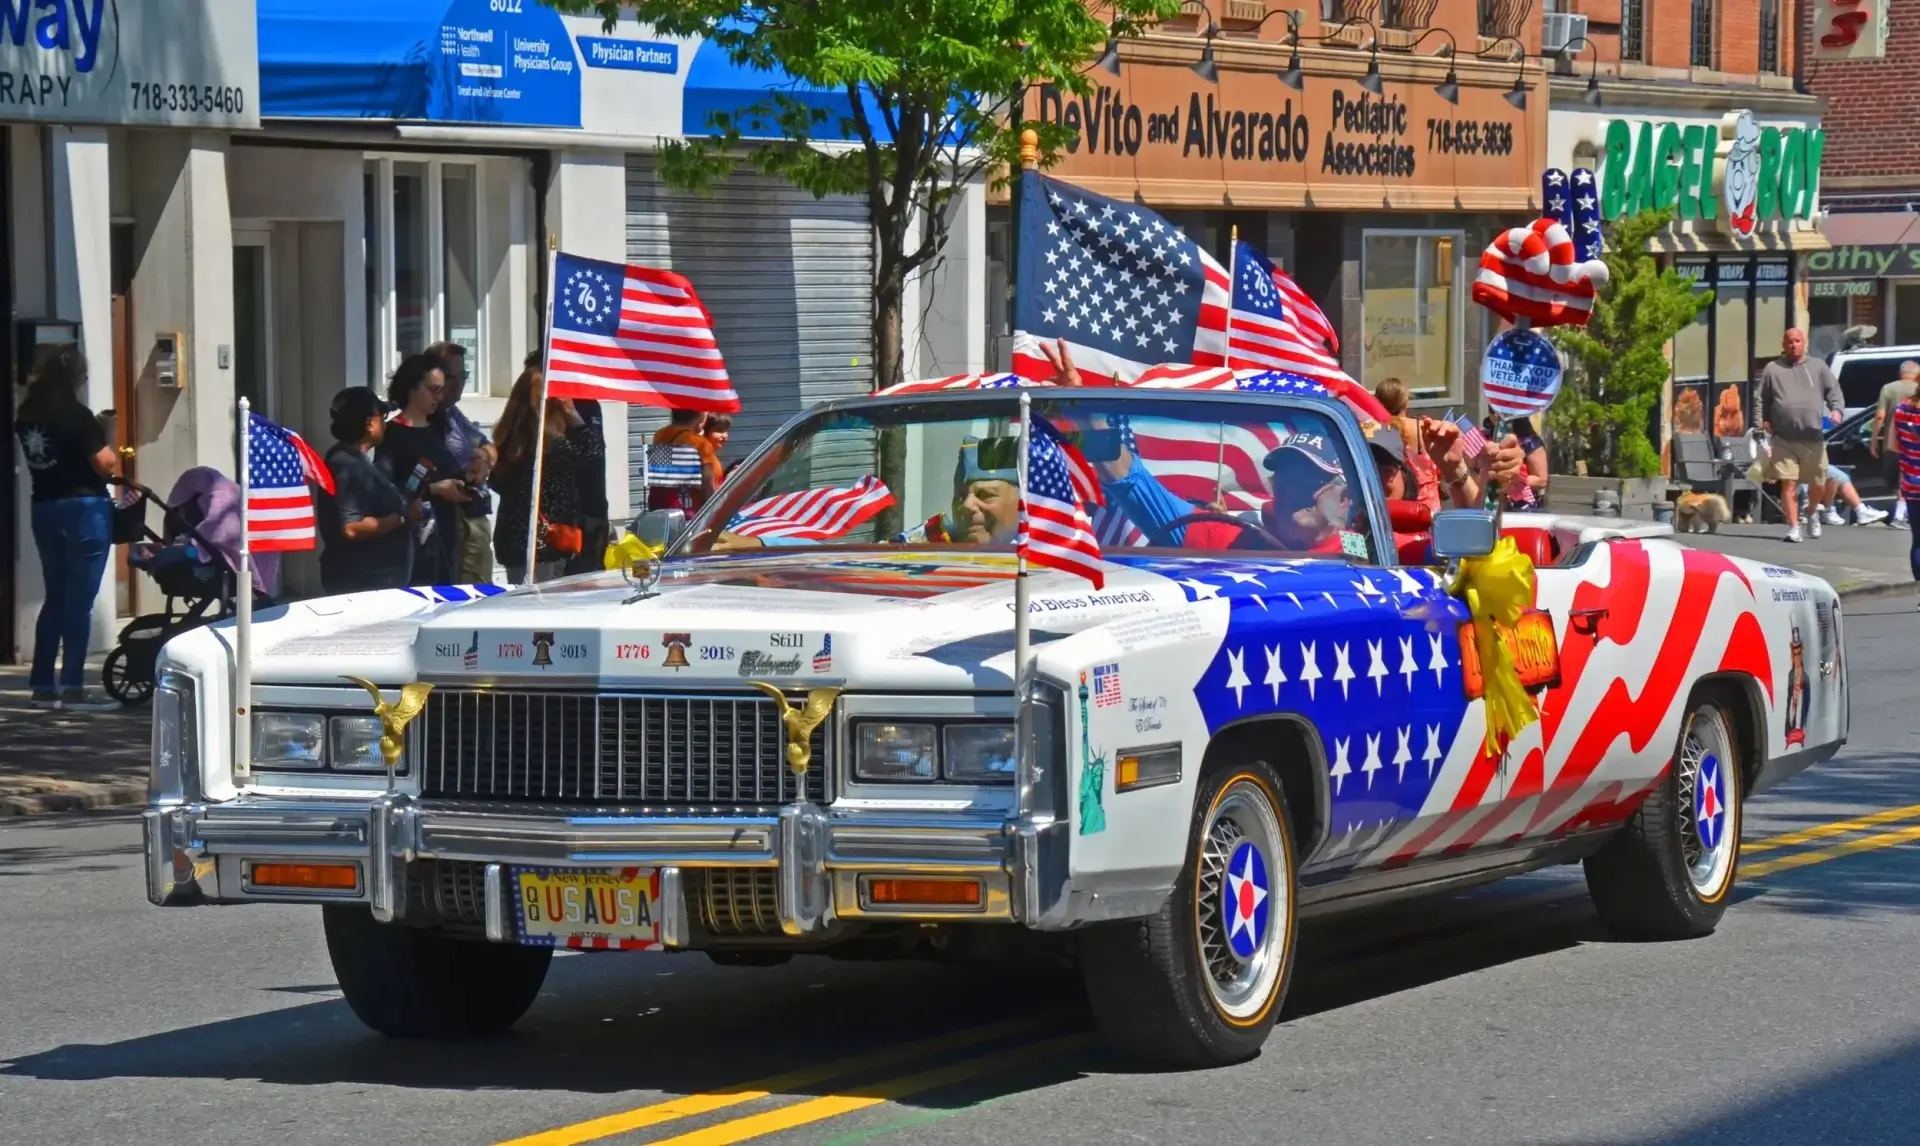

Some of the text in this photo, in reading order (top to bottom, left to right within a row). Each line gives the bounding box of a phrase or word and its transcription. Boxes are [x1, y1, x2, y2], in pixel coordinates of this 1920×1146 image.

[457, 27, 494, 43] Northwell
[457, 43, 480, 57] Health
[513, 38, 550, 56] University
[592, 43, 672, 65] Physician Partners
[513, 55, 550, 73] Physicians
[551, 57, 573, 75] Group
[131, 82, 243, 113] 718-333-5460
[1041, 83, 1309, 162] DeVito and Alvarado
[1333, 89, 1407, 136] Pediatric
[1322, 131, 1415, 177] Associates
[1602, 119, 1826, 221] BAGEL BOY
[1254, 269, 1268, 297] 76
[578, 282, 597, 313] 76
[1490, 360, 1553, 377] THANK YOU
[1490, 370, 1547, 386] VETERANS
[1286, 433, 1323, 450] USA
[1042, 598, 1087, 611] Bless
[1088, 590, 1155, 606] America!
[435, 643, 587, 658] Still 1776 2018
[615, 633, 804, 660] 1776 2018 Still
[551, 873, 622, 887] New Jersey
[546, 886, 652, 927] USAUSA
[571, 931, 613, 939] HISTORIC
